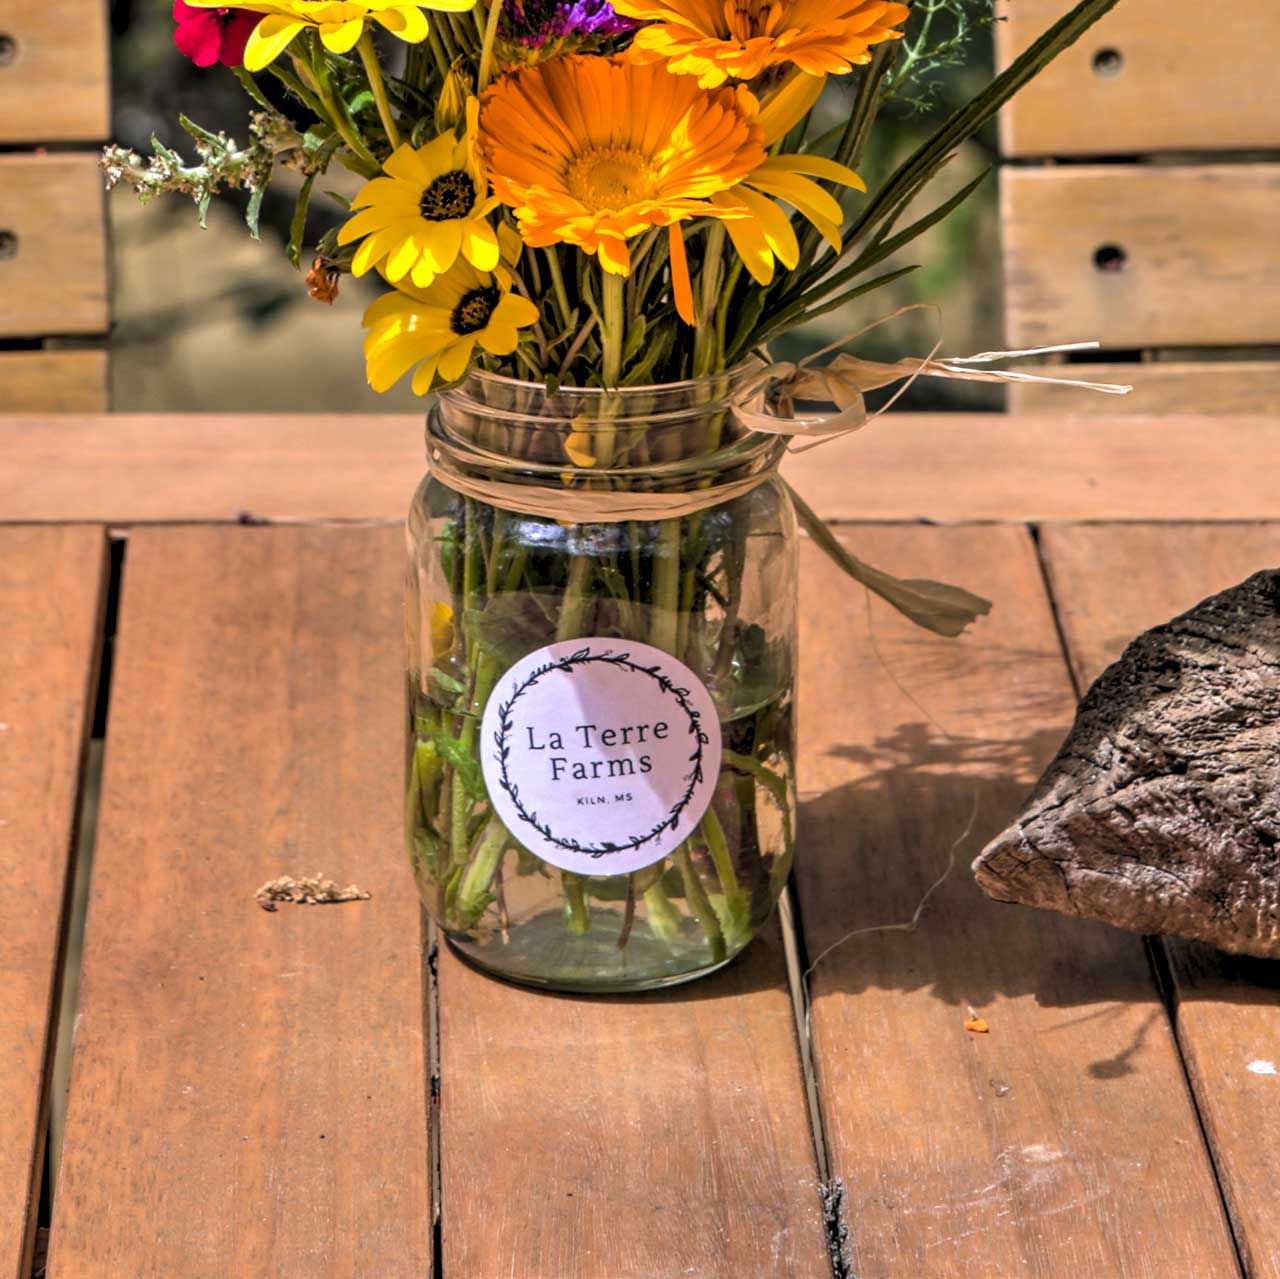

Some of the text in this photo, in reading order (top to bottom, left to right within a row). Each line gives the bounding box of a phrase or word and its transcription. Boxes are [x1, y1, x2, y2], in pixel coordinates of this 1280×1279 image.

[527, 721, 669, 750] La Terre
[550, 755, 653, 781] Farms
[615, 793, 633, 802] MS
